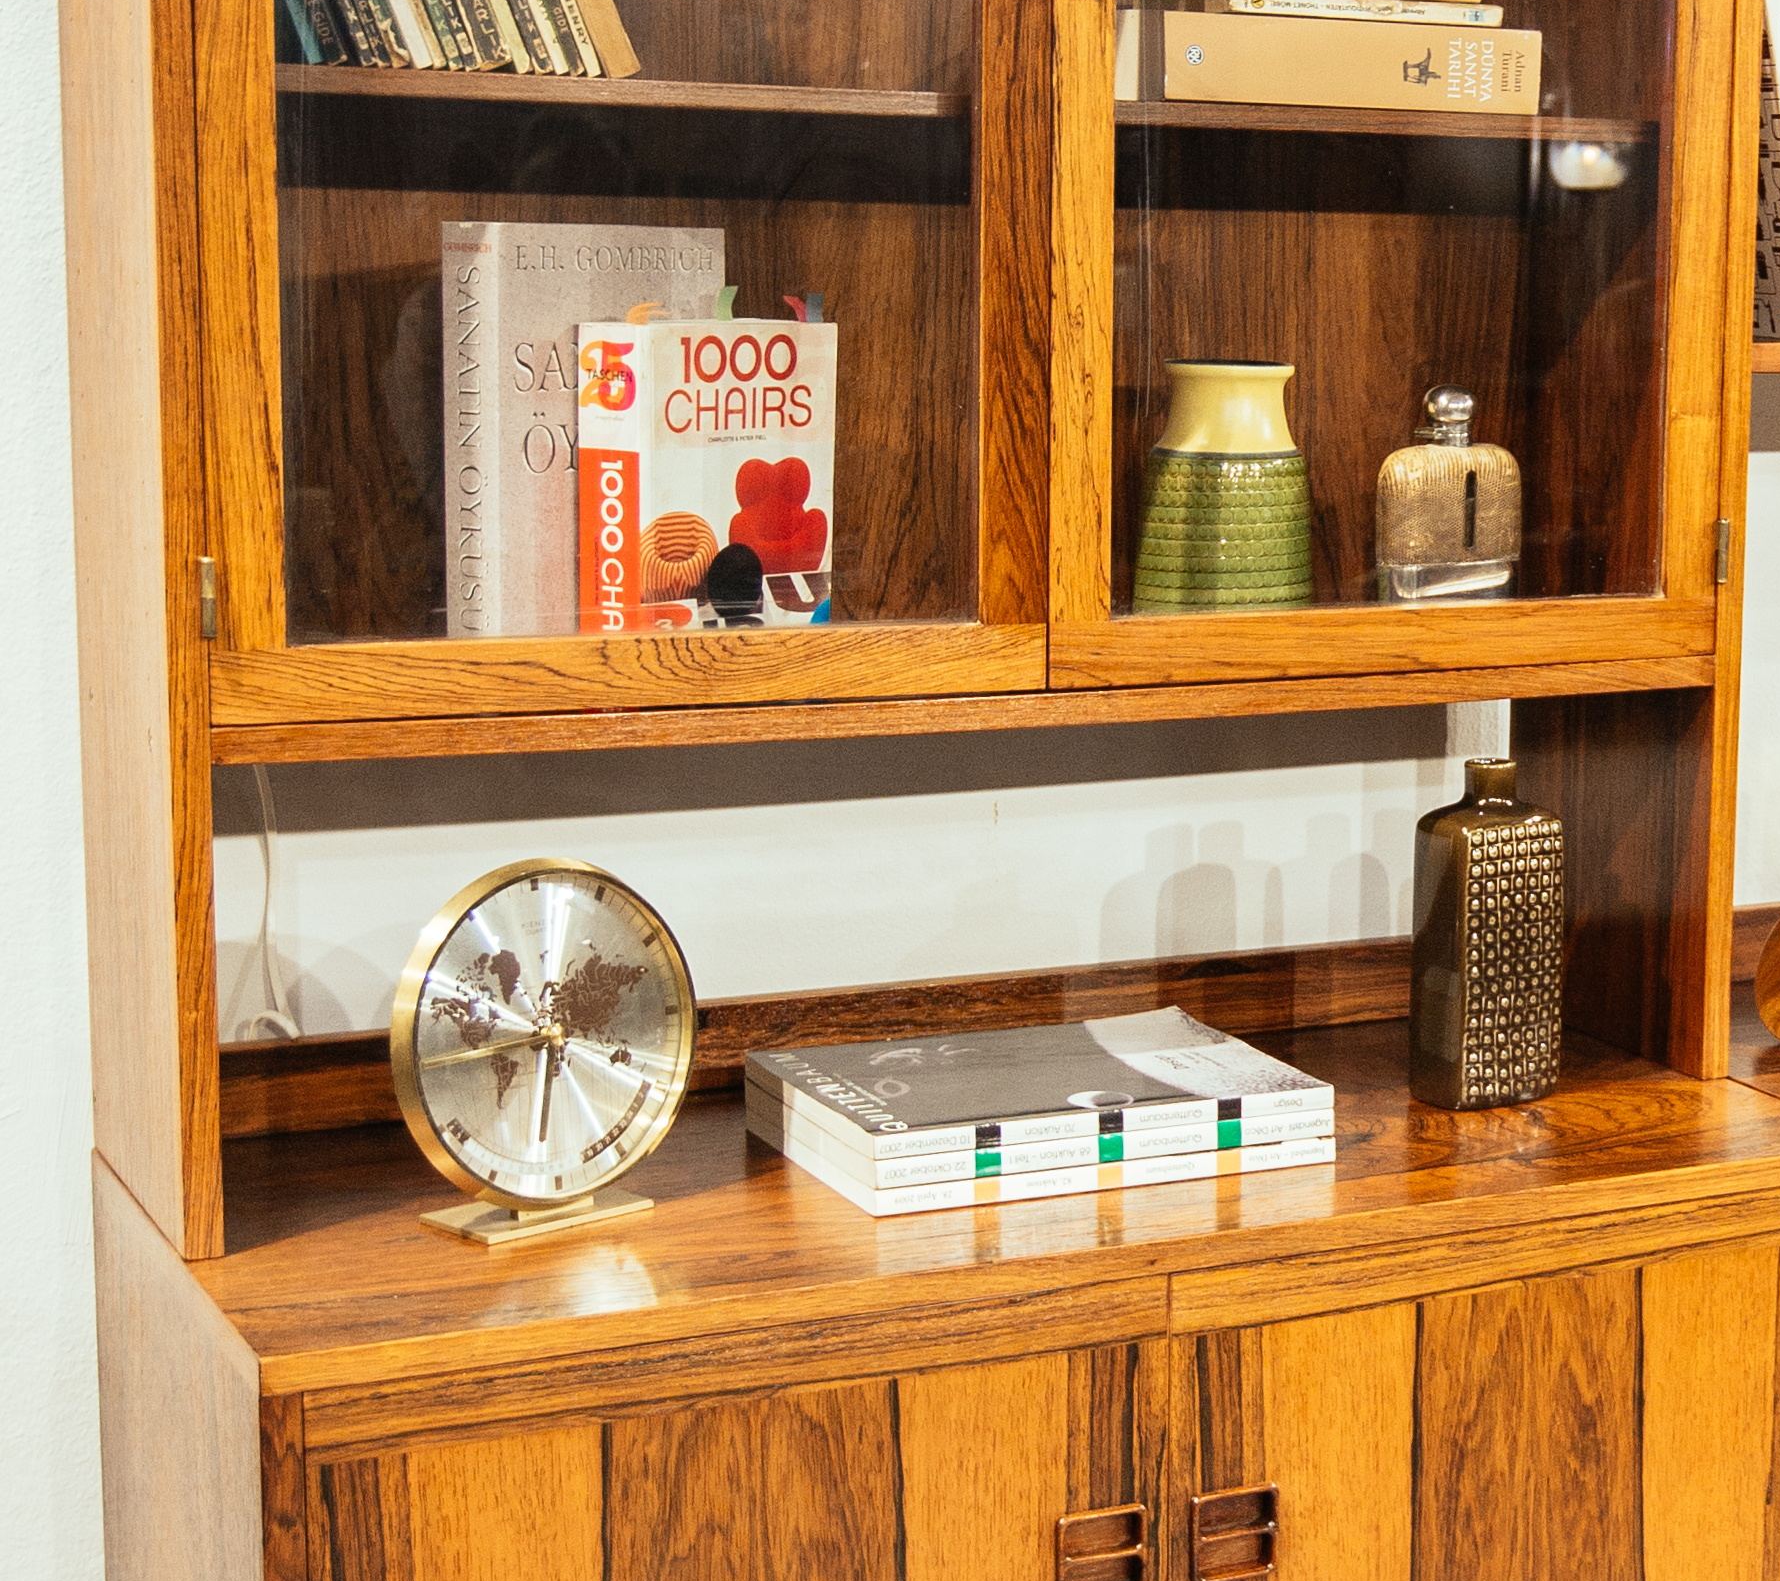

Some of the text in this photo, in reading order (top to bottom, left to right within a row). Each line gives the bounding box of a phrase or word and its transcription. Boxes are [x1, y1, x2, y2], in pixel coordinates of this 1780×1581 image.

[311, 9, 333, 45] GIDE
[551, 6, 569, 34] GIDE
[1447, 37, 1462, 98] TARİHİ
[1463, 42, 1477, 97] SANAT
[1479, 40, 1495, 102] DÜNYA
[1501, 49, 1512, 92] Turani
[1514, 50, 1525, 92] Adnan
[516, 245, 715, 273] E.H. GOMBRICH
[513, 341, 578, 394] SA
[680, 334, 798, 384] 1000
[586, 368, 634, 383] TASCHEN
[664, 384, 813, 434] CHAIRS
[456, 264, 490, 632] SANATIN ÖYKÜSÜ
[599, 459, 624, 630] 1000 CHA
[769, 1053, 909, 1132] QUITTENBAUM
[1273, 1095, 1302, 1110] Design
[1139, 1108, 1202, 1123] Quittenbaum
[1244, 1115, 1330, 1138] Jugendstil Art Déco
[1024, 1122, 1075, 1138] 70. Auktion
[1138, 1132, 1202, 1148] Quittenbaum
[878, 1134, 971, 1154] 10. Dezember 2007
[1039, 1147, 1075, 1162] Auktion
[1077, 1145, 1090, 1157] 68.
[1247, 1144, 1325, 1164] Jugendstil Art Déco
[883, 1159, 966, 1180] 22. Oktober 2007
[1013, 1153, 1029, 1163] Teil
[1145, 1158, 1195, 1176] Quittenbaum
[1025, 1176, 1071, 1189] 82. Auktion
[893, 1189, 952, 1205] 28. April 2009
